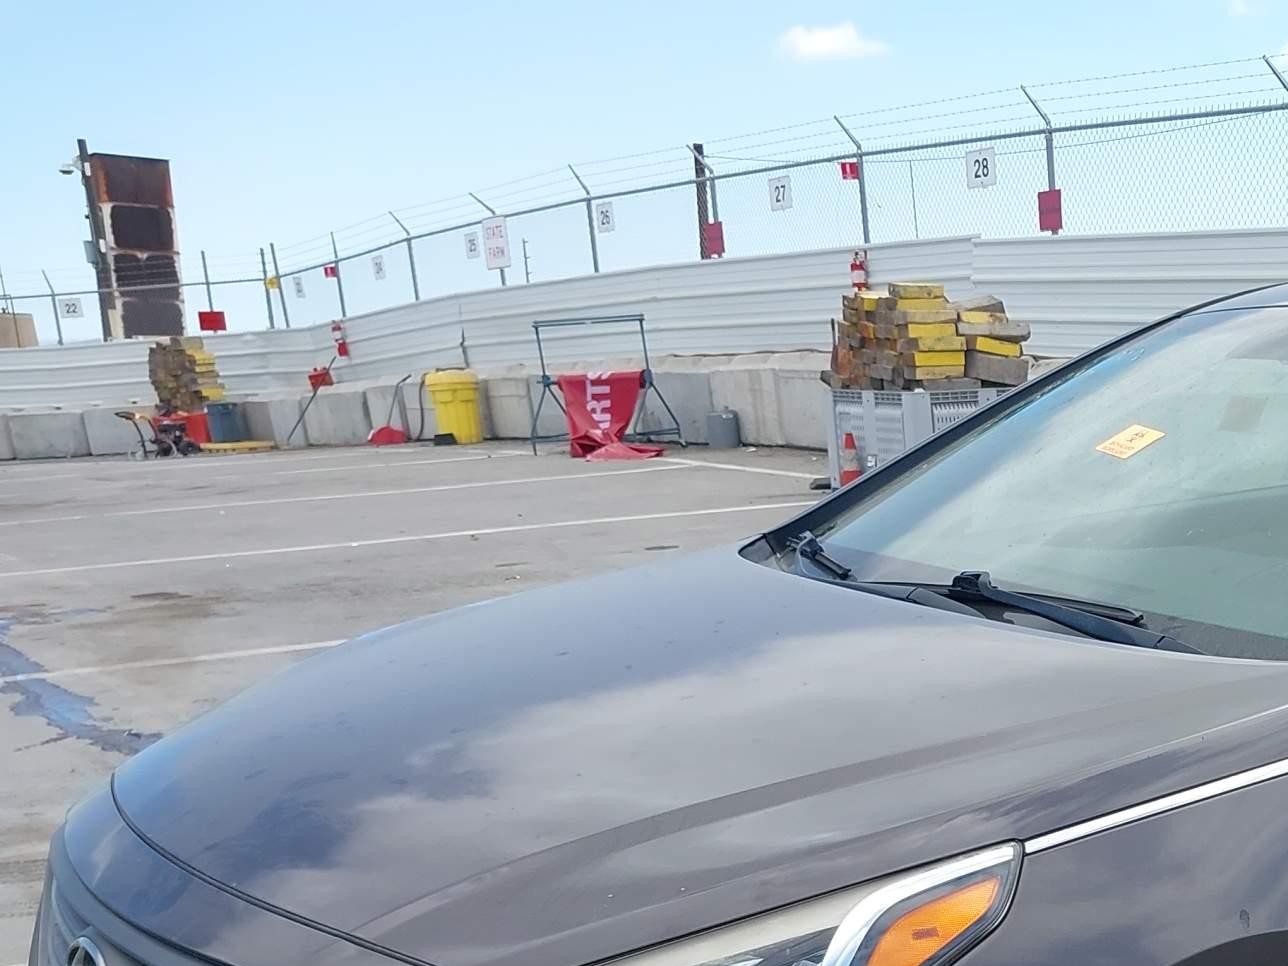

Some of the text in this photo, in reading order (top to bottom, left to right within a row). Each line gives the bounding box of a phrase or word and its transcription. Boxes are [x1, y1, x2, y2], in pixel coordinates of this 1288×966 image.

[973, 157, 989, 179] 28
[774, 184, 786, 203] 27
[601, 210, 611, 225] 26
[65, 303, 78, 314] 22
